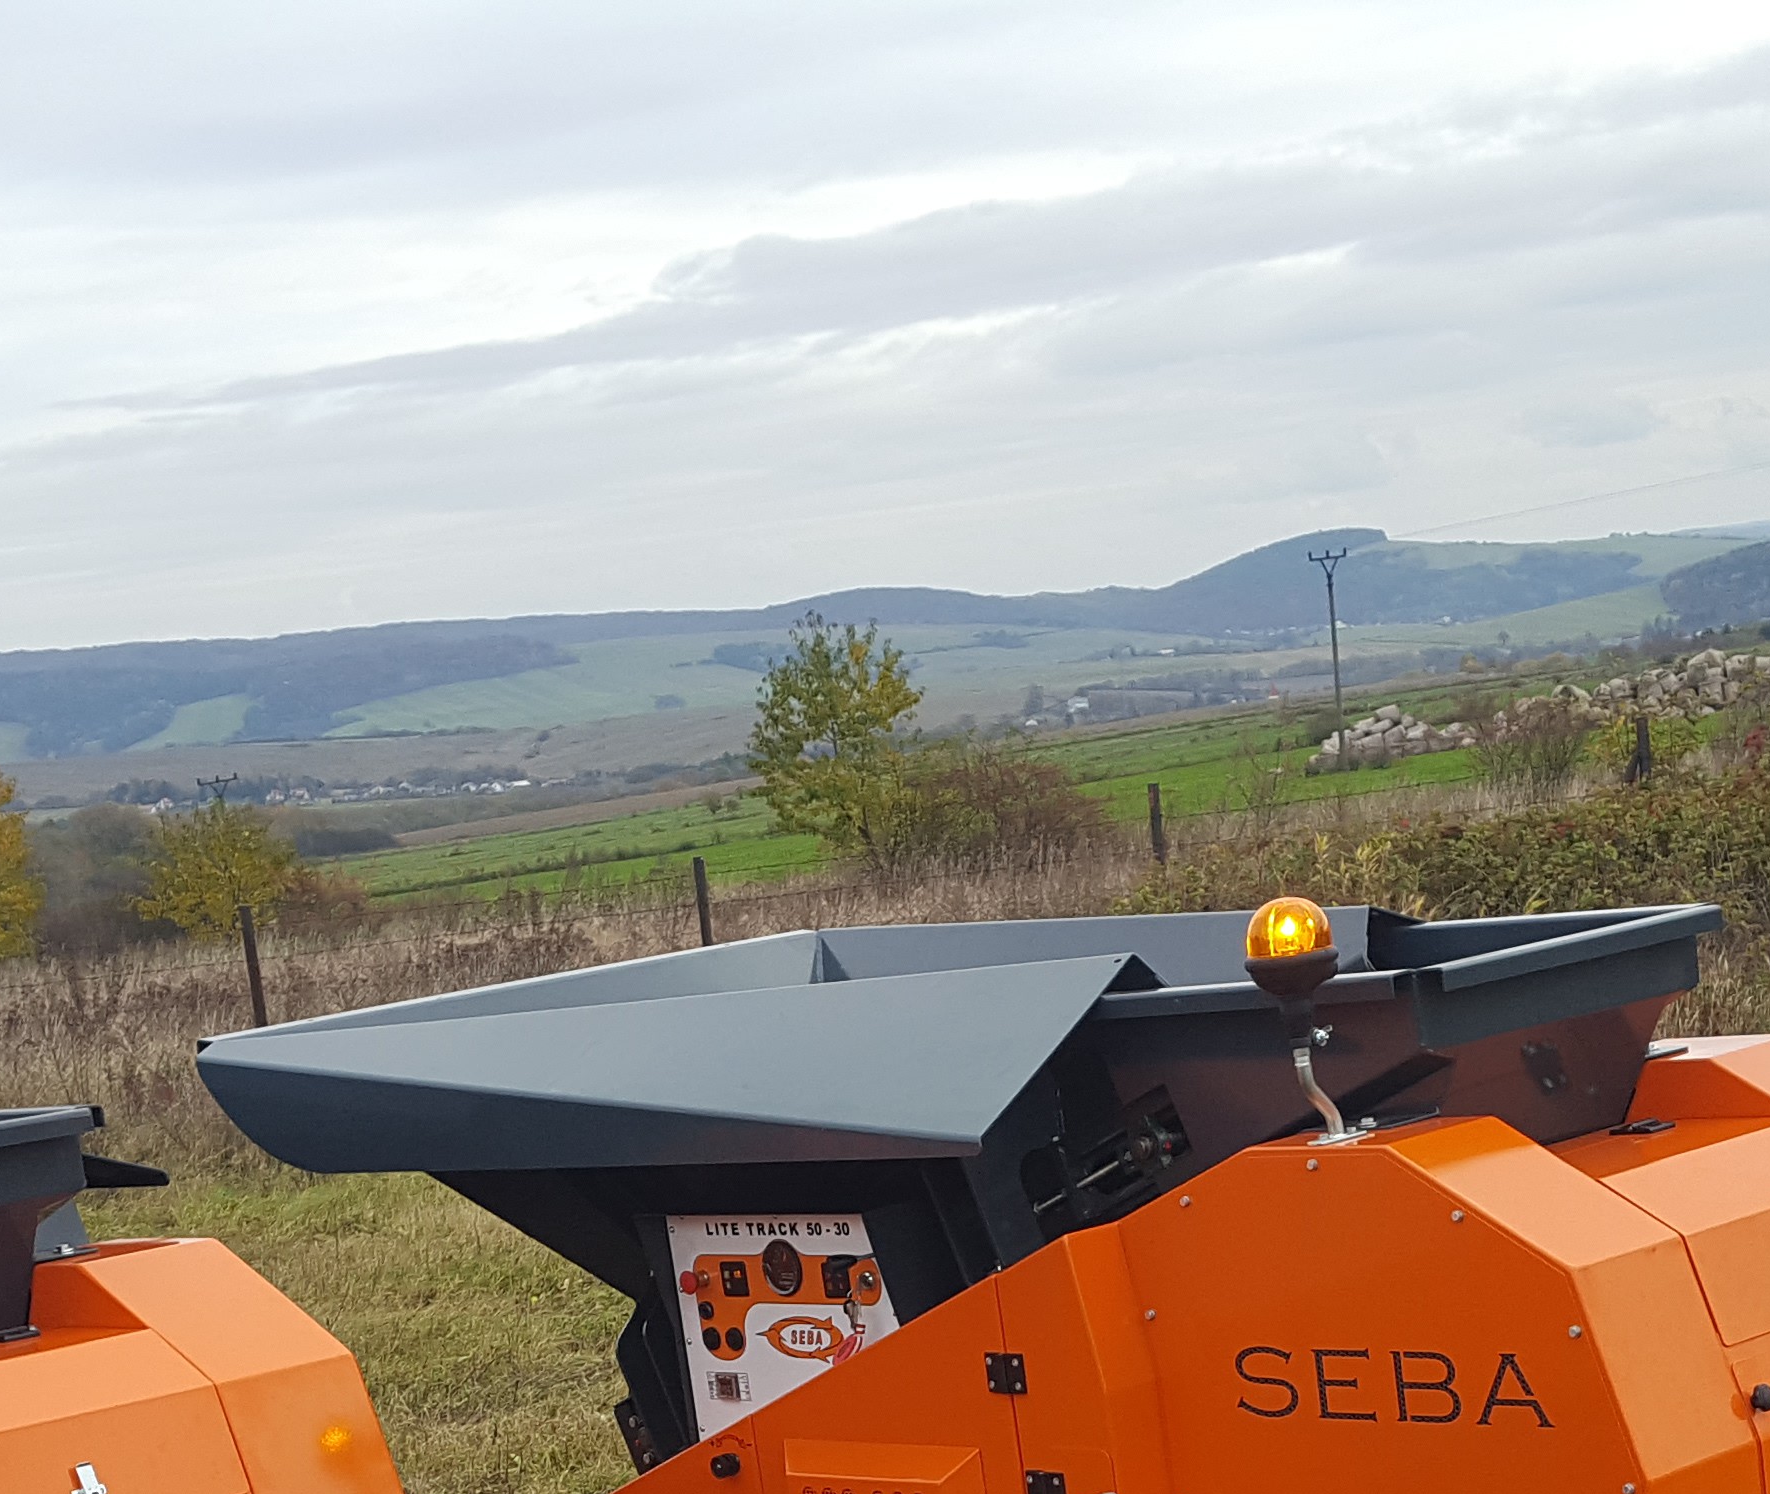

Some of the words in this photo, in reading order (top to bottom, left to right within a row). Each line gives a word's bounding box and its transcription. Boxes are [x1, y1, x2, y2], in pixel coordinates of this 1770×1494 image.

[705, 1222, 740, 1236] LITE
[746, 1222, 799, 1236] TRACK
[806, 1222, 822, 1236] 50
[834, 1222, 850, 1236] 30
[790, 1329, 823, 1346] SEBA
[1234, 1345, 1556, 1429] SEBA
